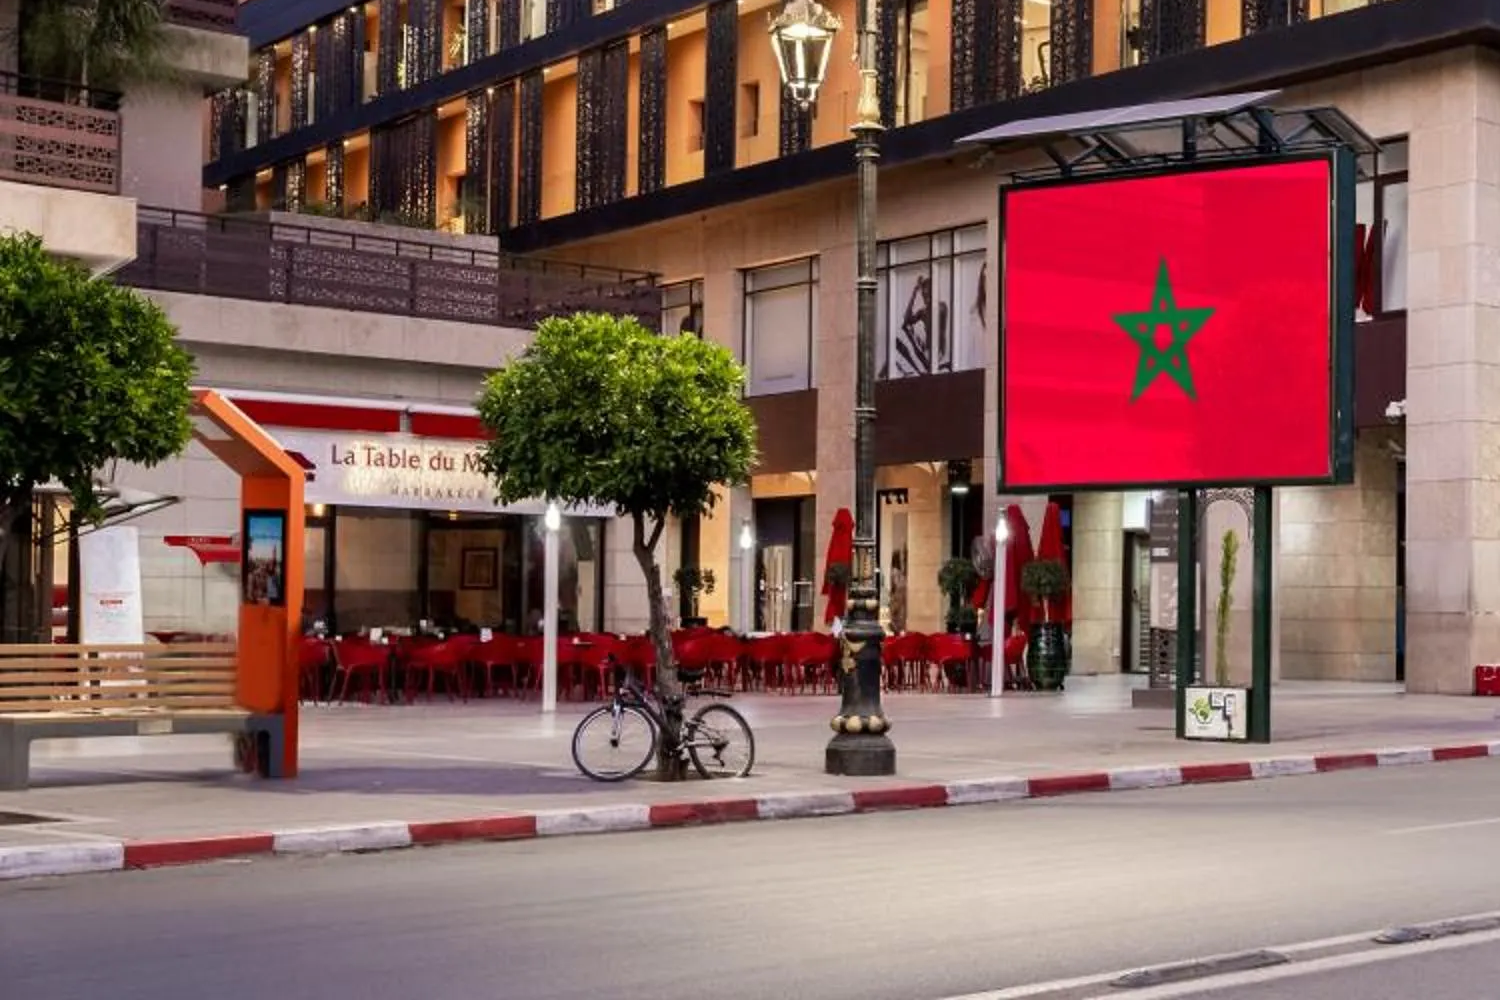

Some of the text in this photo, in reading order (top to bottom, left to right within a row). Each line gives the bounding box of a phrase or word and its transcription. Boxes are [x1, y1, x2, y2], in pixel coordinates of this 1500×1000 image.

[331, 444, 356, 466] La
[364, 446, 421, 470] Table
[429, 451, 455, 472] du
